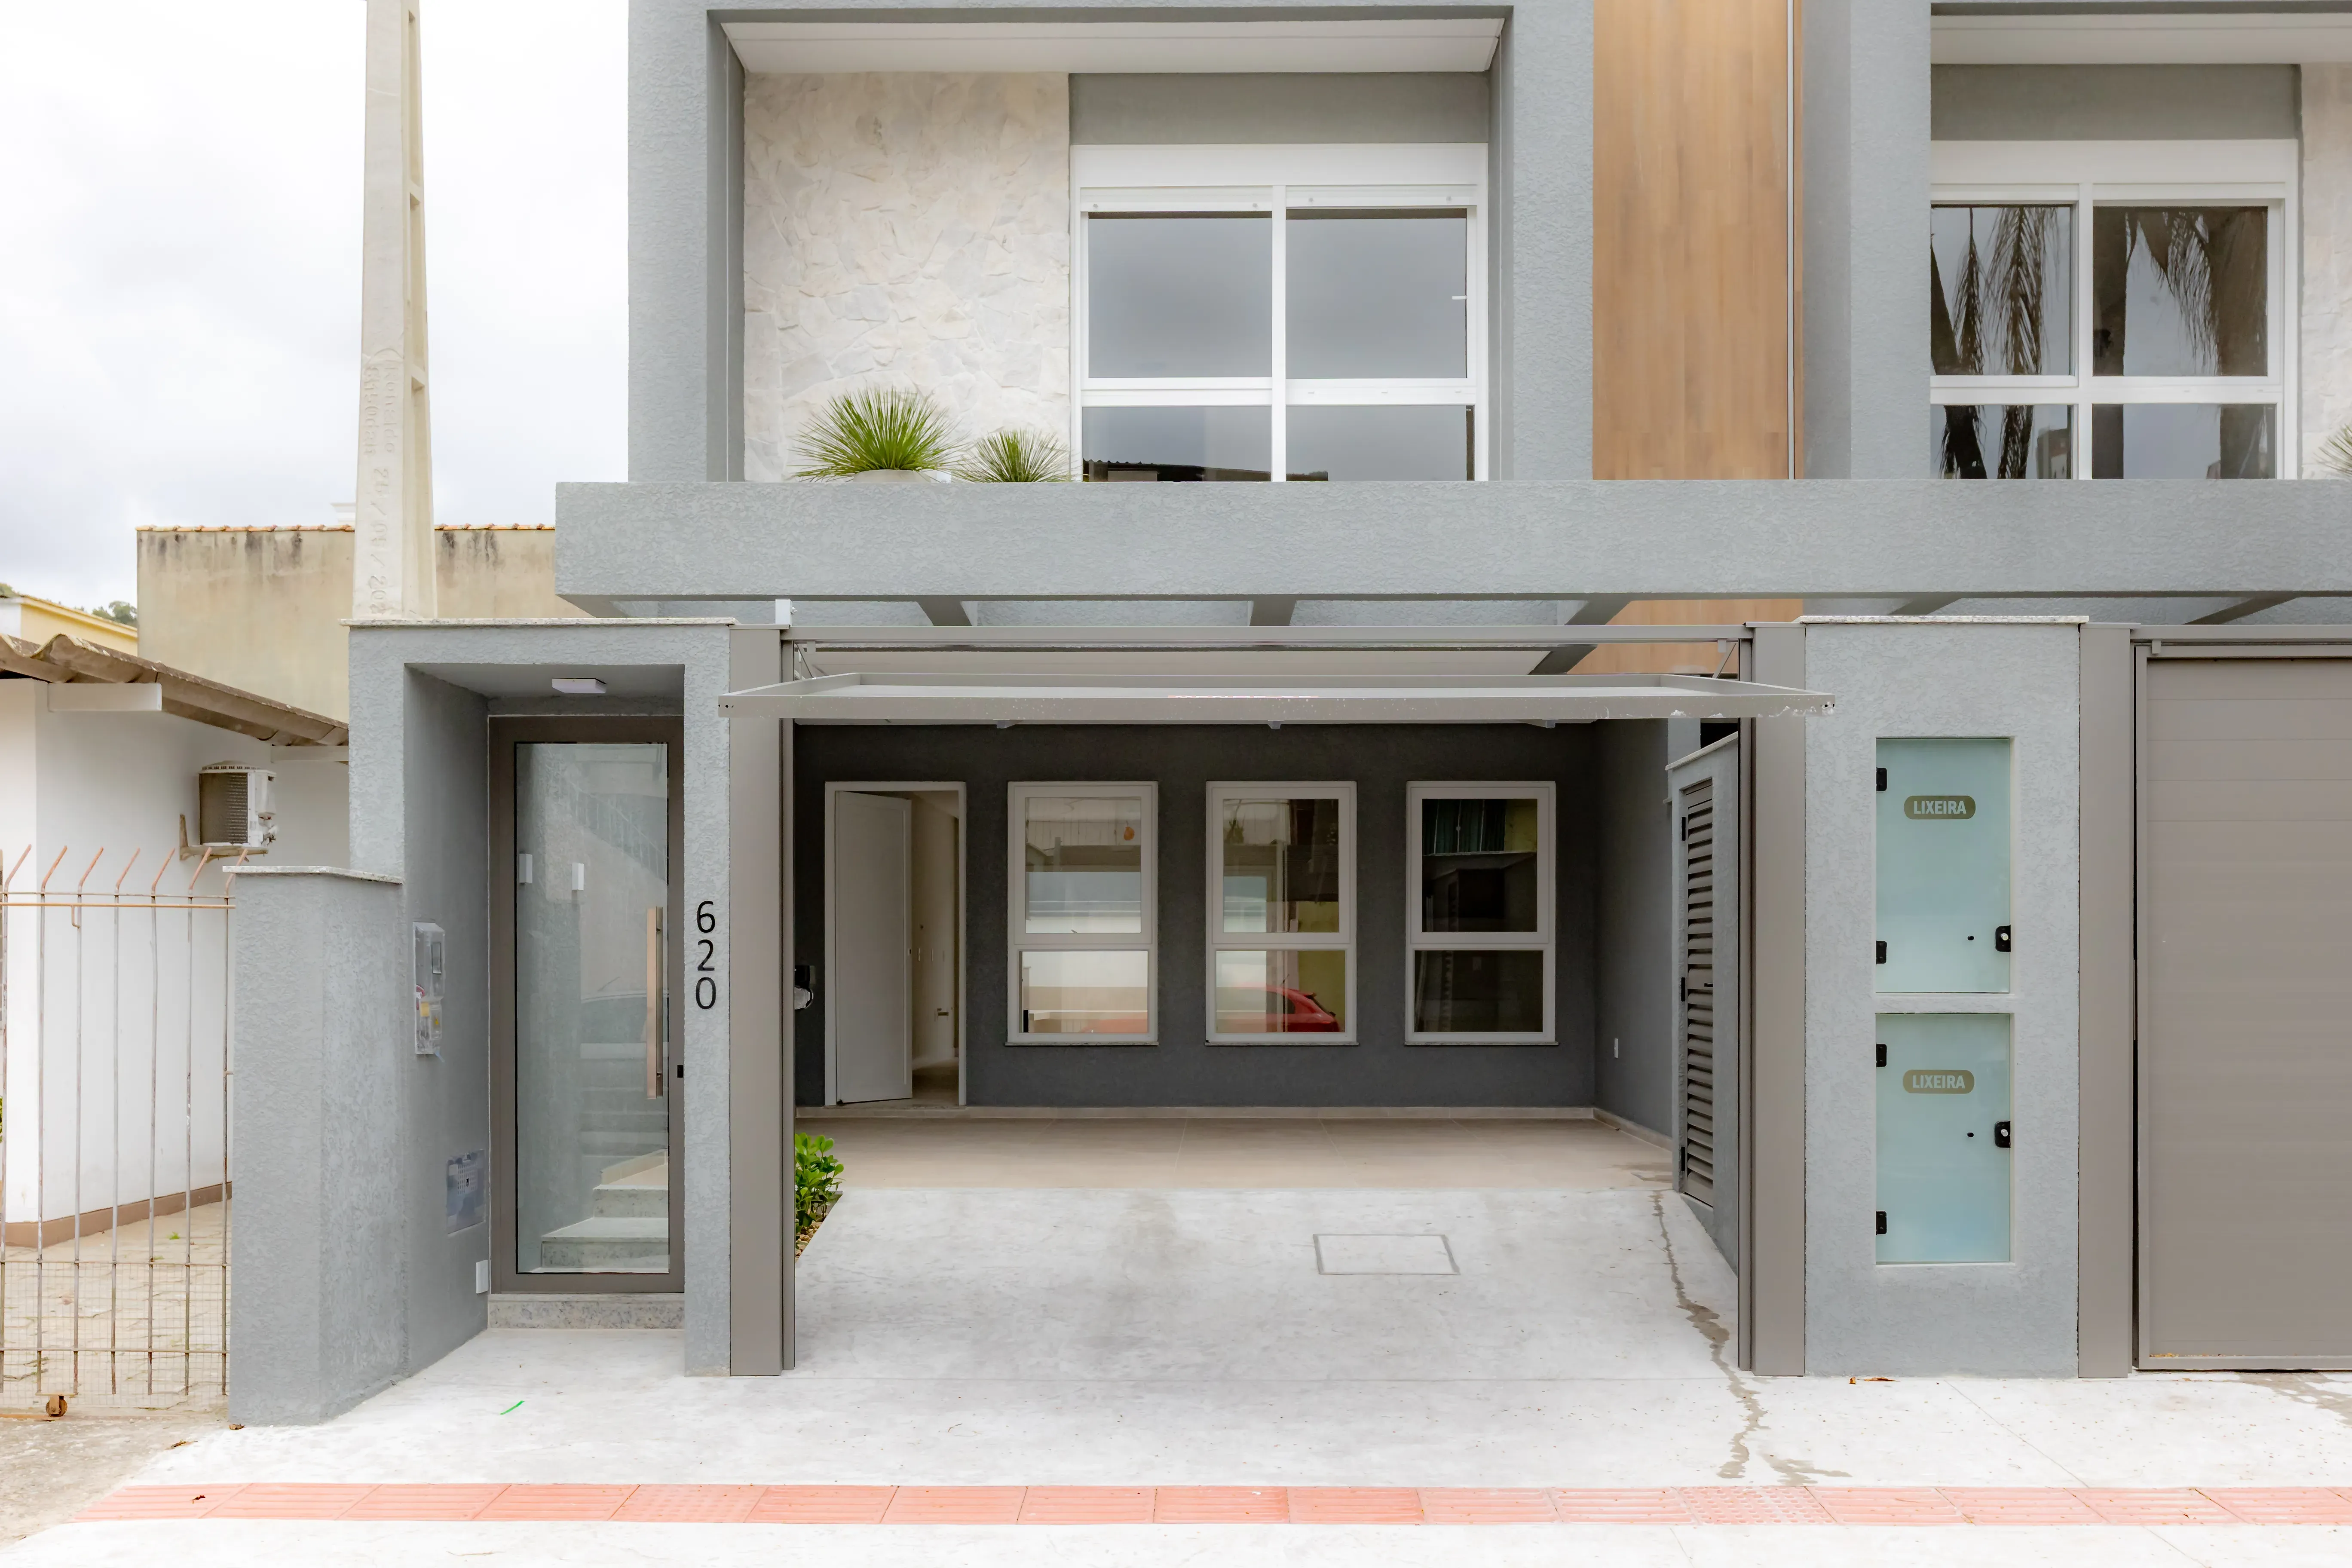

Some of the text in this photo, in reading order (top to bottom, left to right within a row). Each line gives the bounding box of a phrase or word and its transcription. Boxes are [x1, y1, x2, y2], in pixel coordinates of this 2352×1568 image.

[1914, 801, 1966, 814] LIXEIRA
[695, 900, 717, 1010] 620
[1912, 1075, 1965, 1089] LIXEIRA
